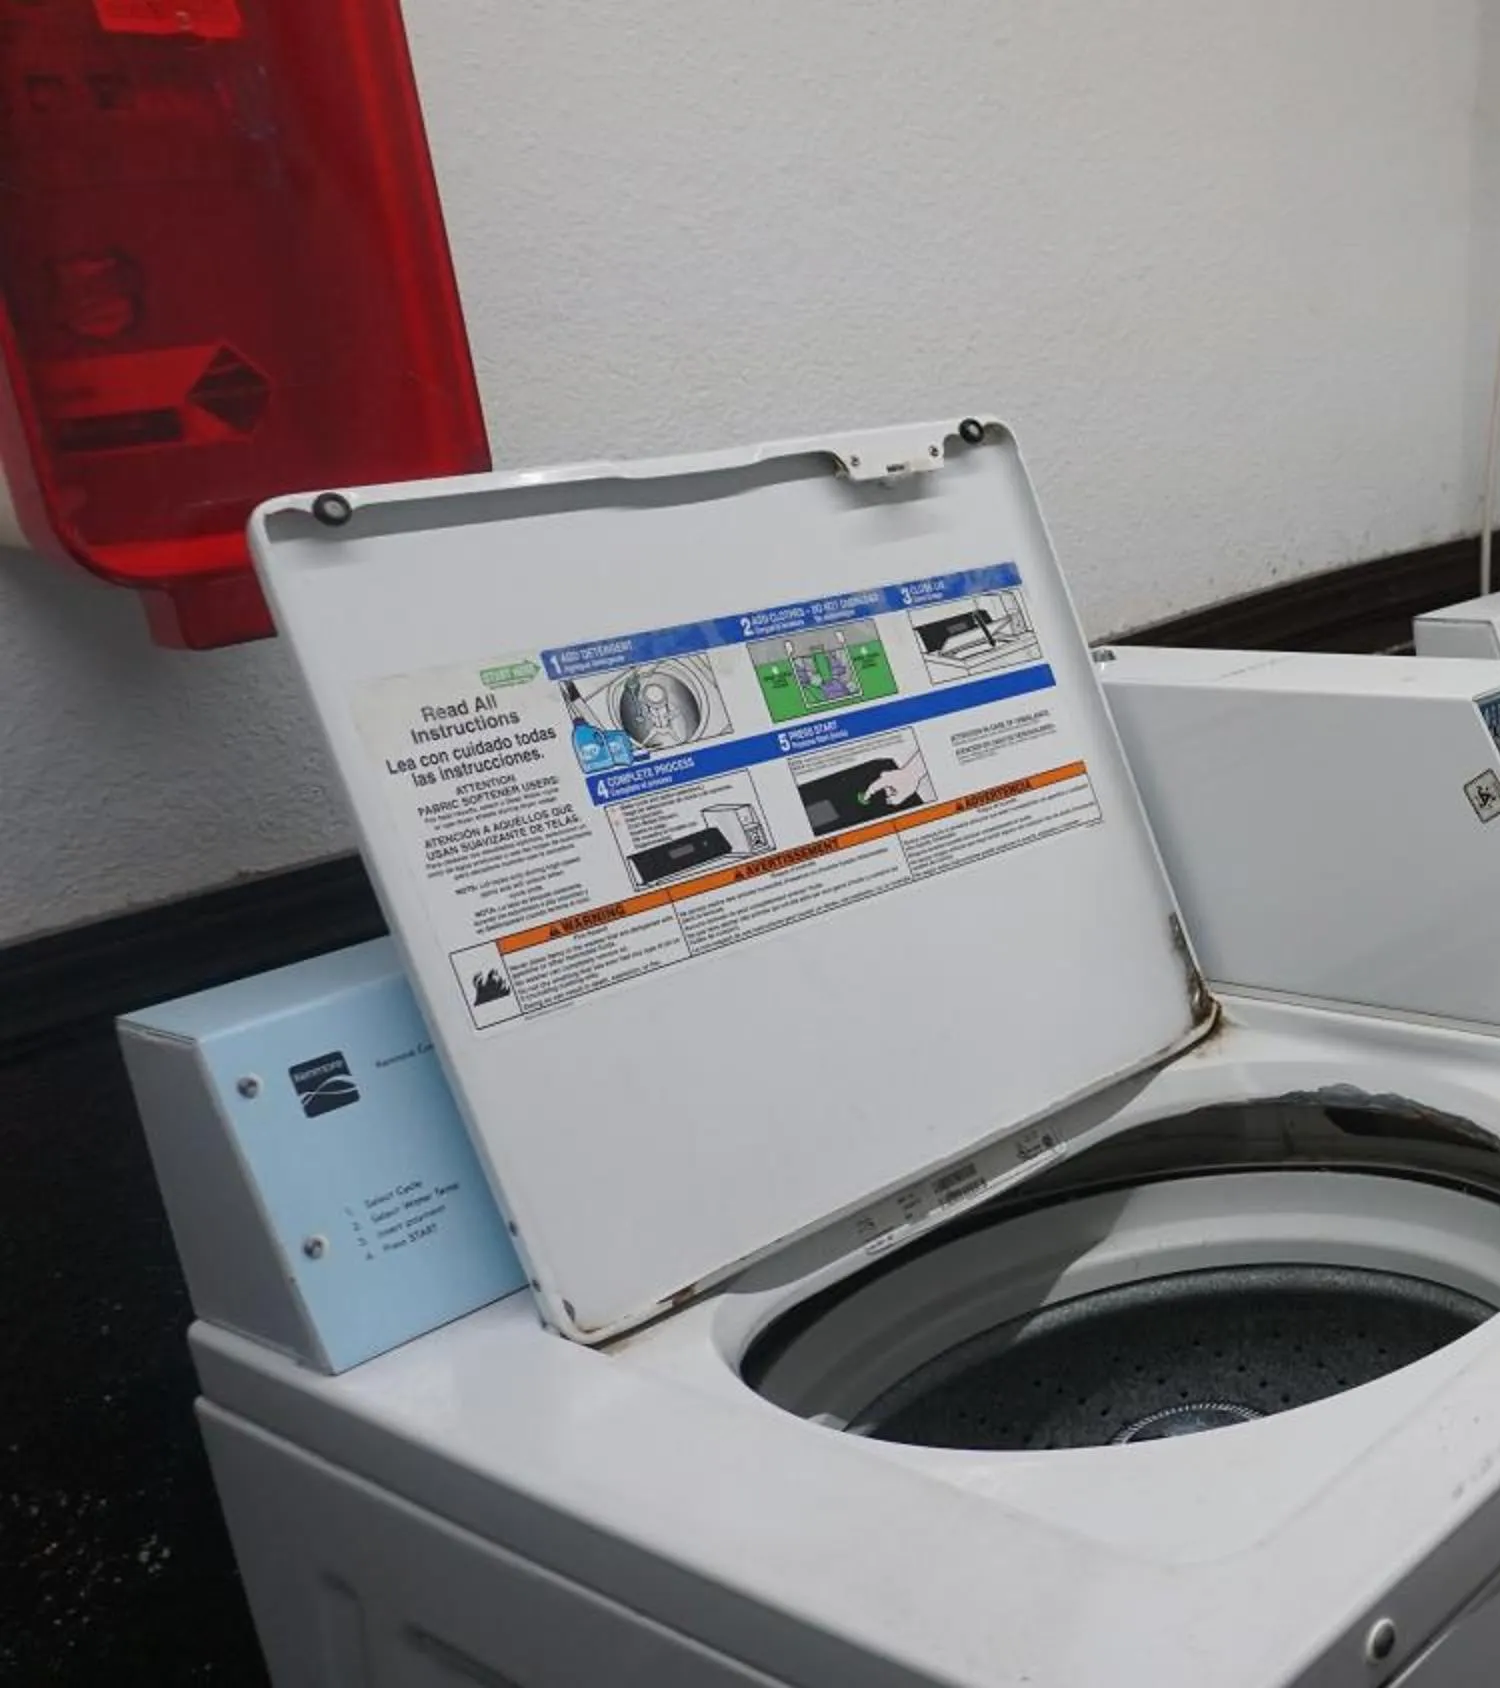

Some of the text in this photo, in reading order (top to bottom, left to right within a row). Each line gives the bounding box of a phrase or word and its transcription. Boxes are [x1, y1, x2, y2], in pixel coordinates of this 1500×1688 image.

[901, 589, 912, 604] 3
[740, 620, 754, 636] 2
[752, 615, 768, 624] ADD
[769, 608, 804, 622] CLOTHES
[549, 656, 562, 674] 1
[580, 640, 632, 660] DETERGENT
[421, 694, 497, 722] Read All
[411, 712, 520, 744] Instructions
[778, 720, 836, 751] 5 PRESS START
[386, 728, 556, 774] Lea con cuidado todas
[412, 749, 544, 787] las instrucciones.
[594, 757, 694, 798] 4 COMPLETE PROCESS
[456, 774, 516, 796] ATTENTION
[966, 779, 1032, 808] ADVERTENCIA
[418, 800, 459, 816] FABRIC
[462, 785, 520, 806] SOFTENER
[482, 826, 491, 834] A
[494, 810, 549, 832] AQUELLOS
[552, 804, 574, 816] QUE
[426, 846, 458, 860] USAN
[460, 828, 527, 852] SUAVIZANTE
[530, 824, 544, 834] DE
[747, 838, 838, 876] AVERTISSEMENT
[560, 905, 625, 932] WARNING
[364, 1190, 394, 1208] Select
[396, 1180, 423, 1196] Cycle
[371, 1206, 400, 1223] Select
[408, 1223, 437, 1243] START
